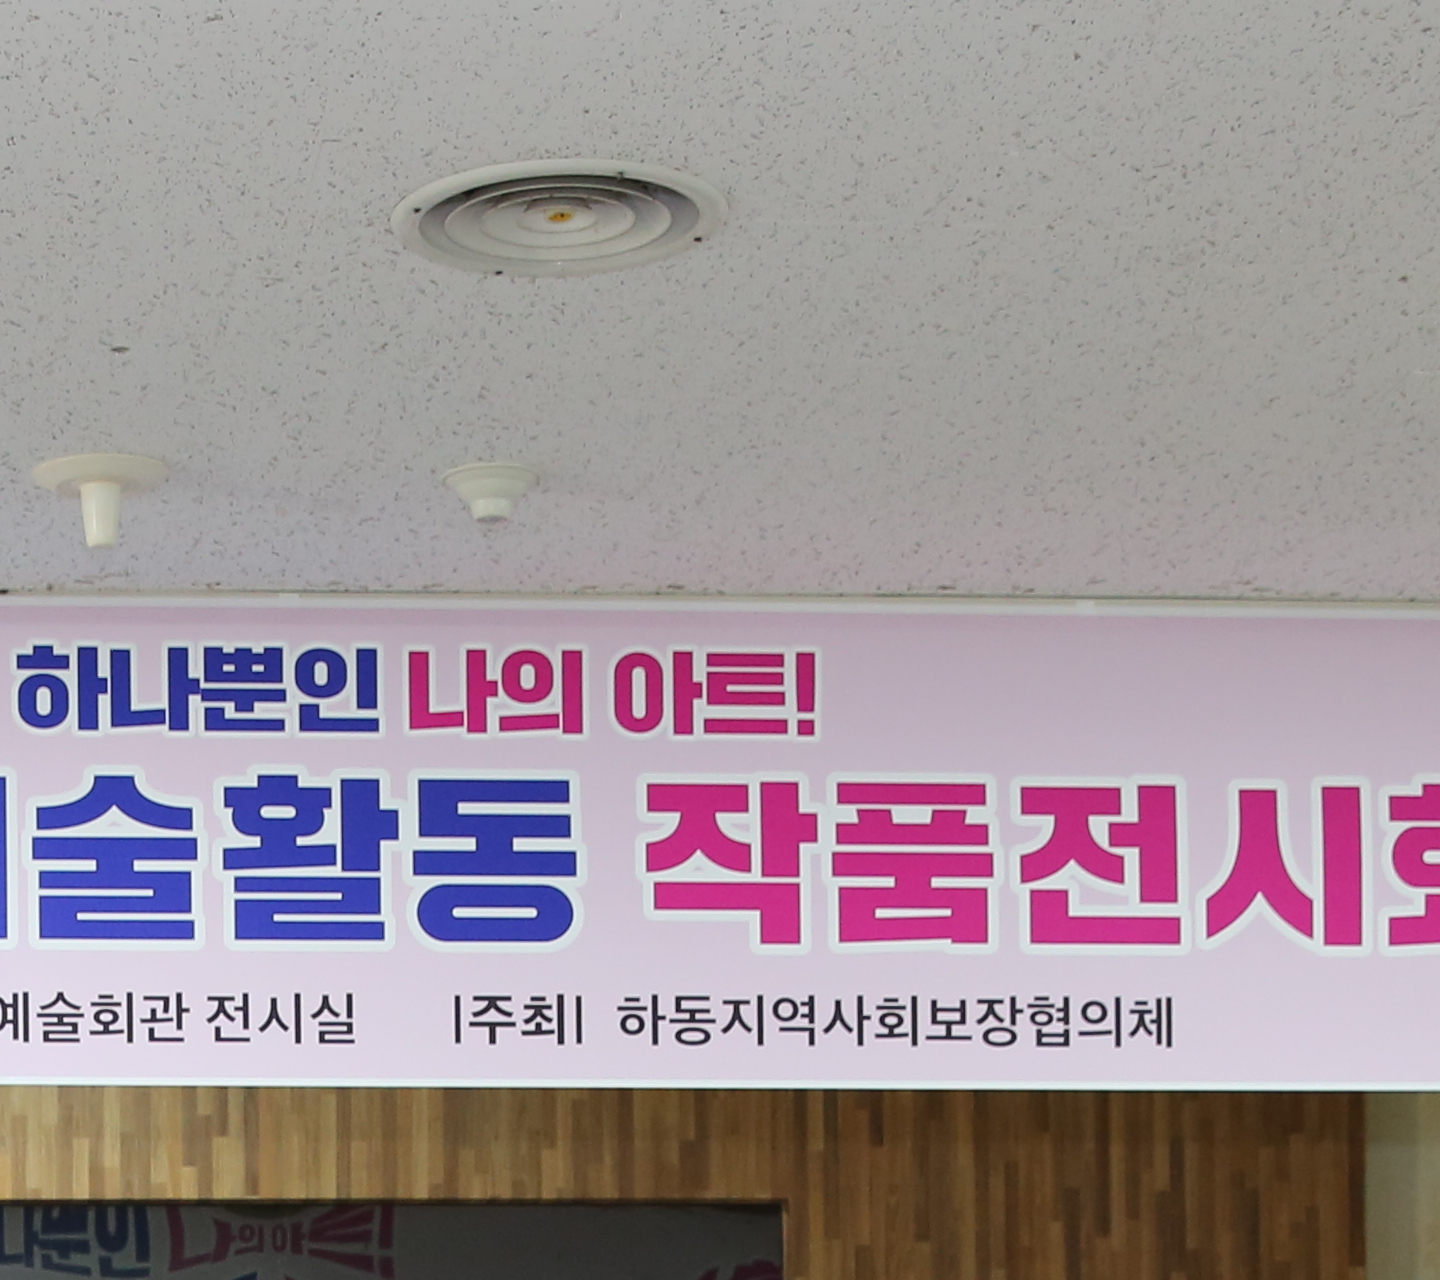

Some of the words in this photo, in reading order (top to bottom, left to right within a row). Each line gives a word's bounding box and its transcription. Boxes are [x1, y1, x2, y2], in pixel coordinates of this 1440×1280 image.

[18, 645, 379, 732] 하나뿐인
[408, 649, 584, 734] 나의
[614, 651, 817, 736] 아트!
[206, 992, 356, 1044] 전시실
[617, 994, 1174, 1048] 하동지역사회보장협의체
